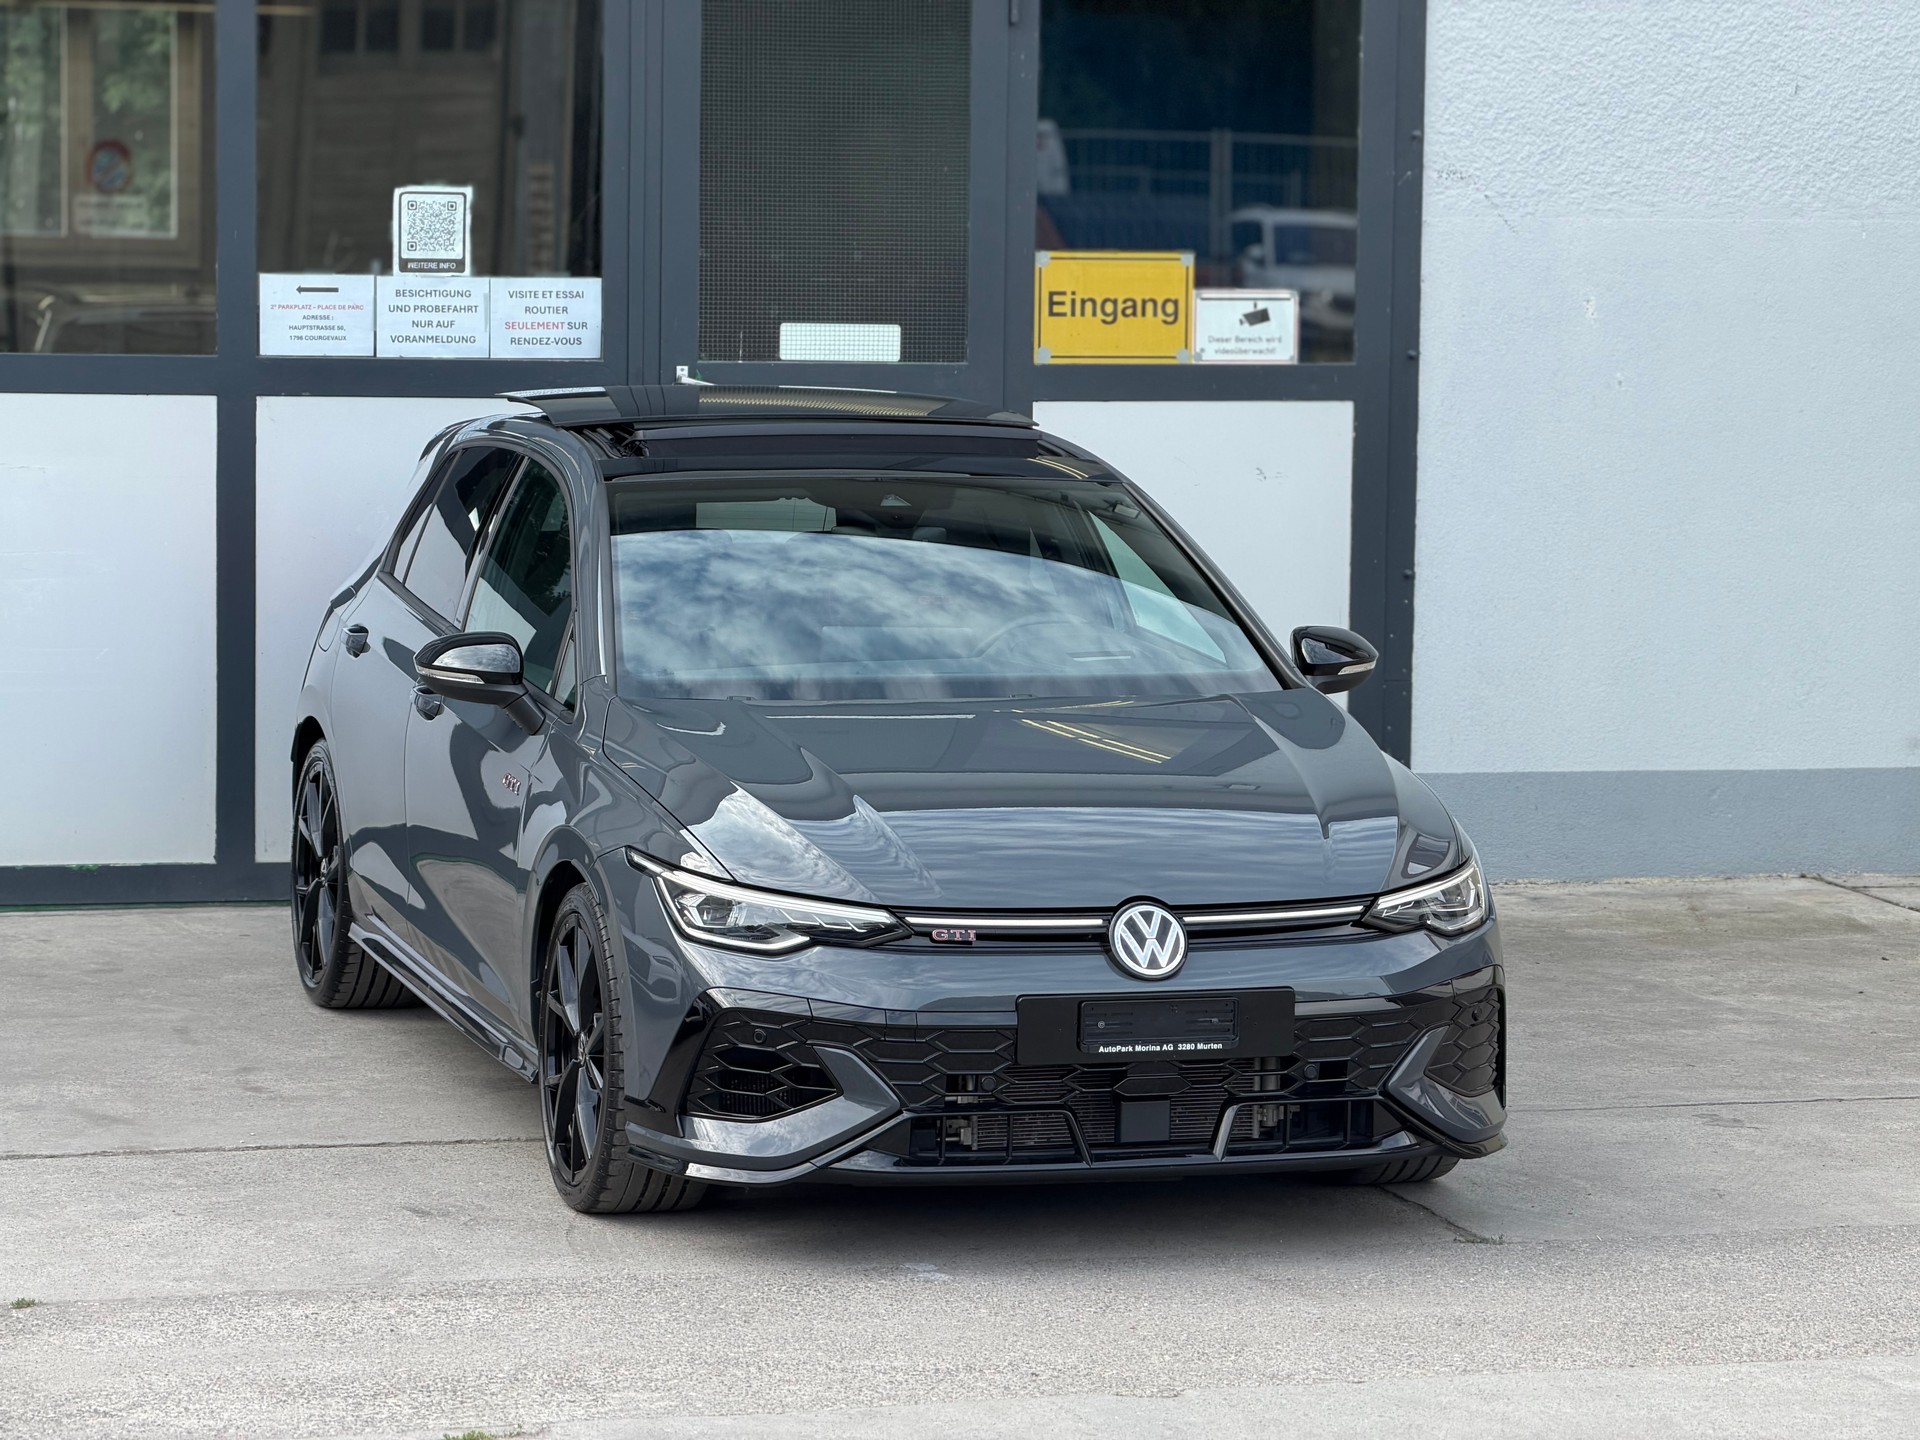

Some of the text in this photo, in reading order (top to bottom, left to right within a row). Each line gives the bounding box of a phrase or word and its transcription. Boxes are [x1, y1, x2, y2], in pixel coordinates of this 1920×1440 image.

[395, 290, 472, 298] BESICHTIGUNG
[508, 290, 584, 299] VISITE ET ESSAI
[388, 305, 479, 313] UND PROBEFAHRT
[524, 306, 569, 314] ROUTIER
[1047, 290, 1180, 326] Eingang
[505, 322, 588, 330] SEULEMENT SUR
[390, 336, 476, 344] VORANMELDUNG
[510, 337, 582, 346] RENDEZ-VOUS
[932, 929, 976, 941] GTI
[1116, 908, 1182, 972] VW
